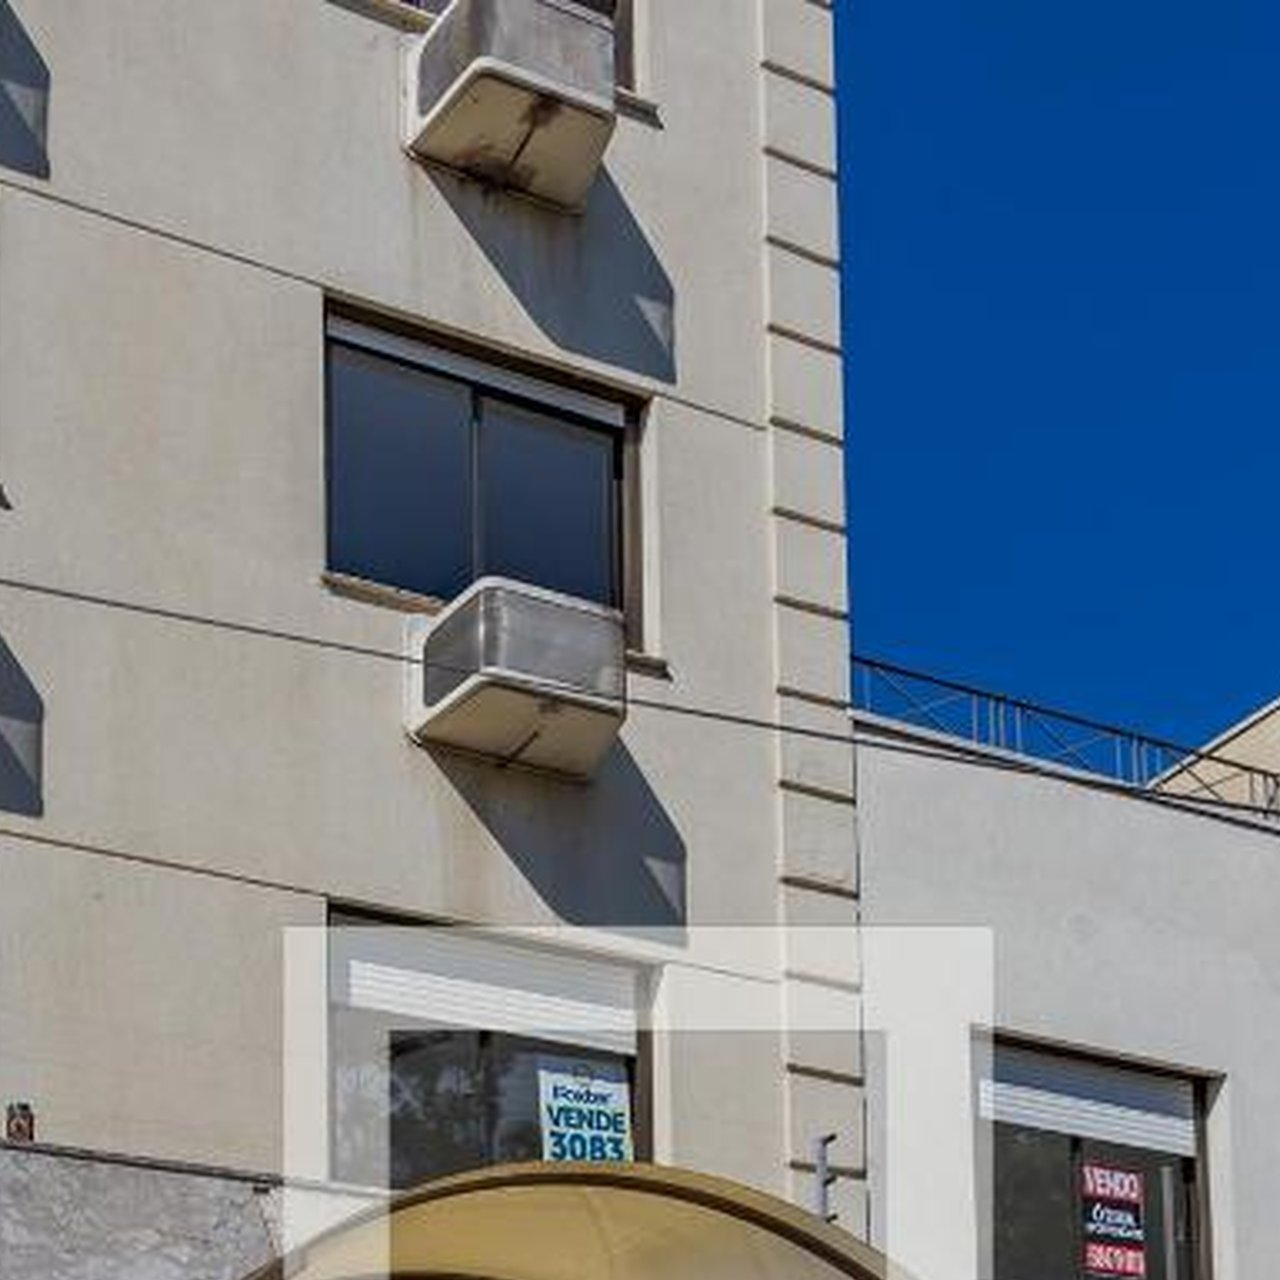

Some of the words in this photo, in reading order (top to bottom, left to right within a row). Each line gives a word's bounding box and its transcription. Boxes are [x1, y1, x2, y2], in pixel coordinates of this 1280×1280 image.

[546, 1104, 627, 1135] VENDE
[549, 1130, 625, 1161] 3083
[1082, 1164, 1139, 1199] VENDO
